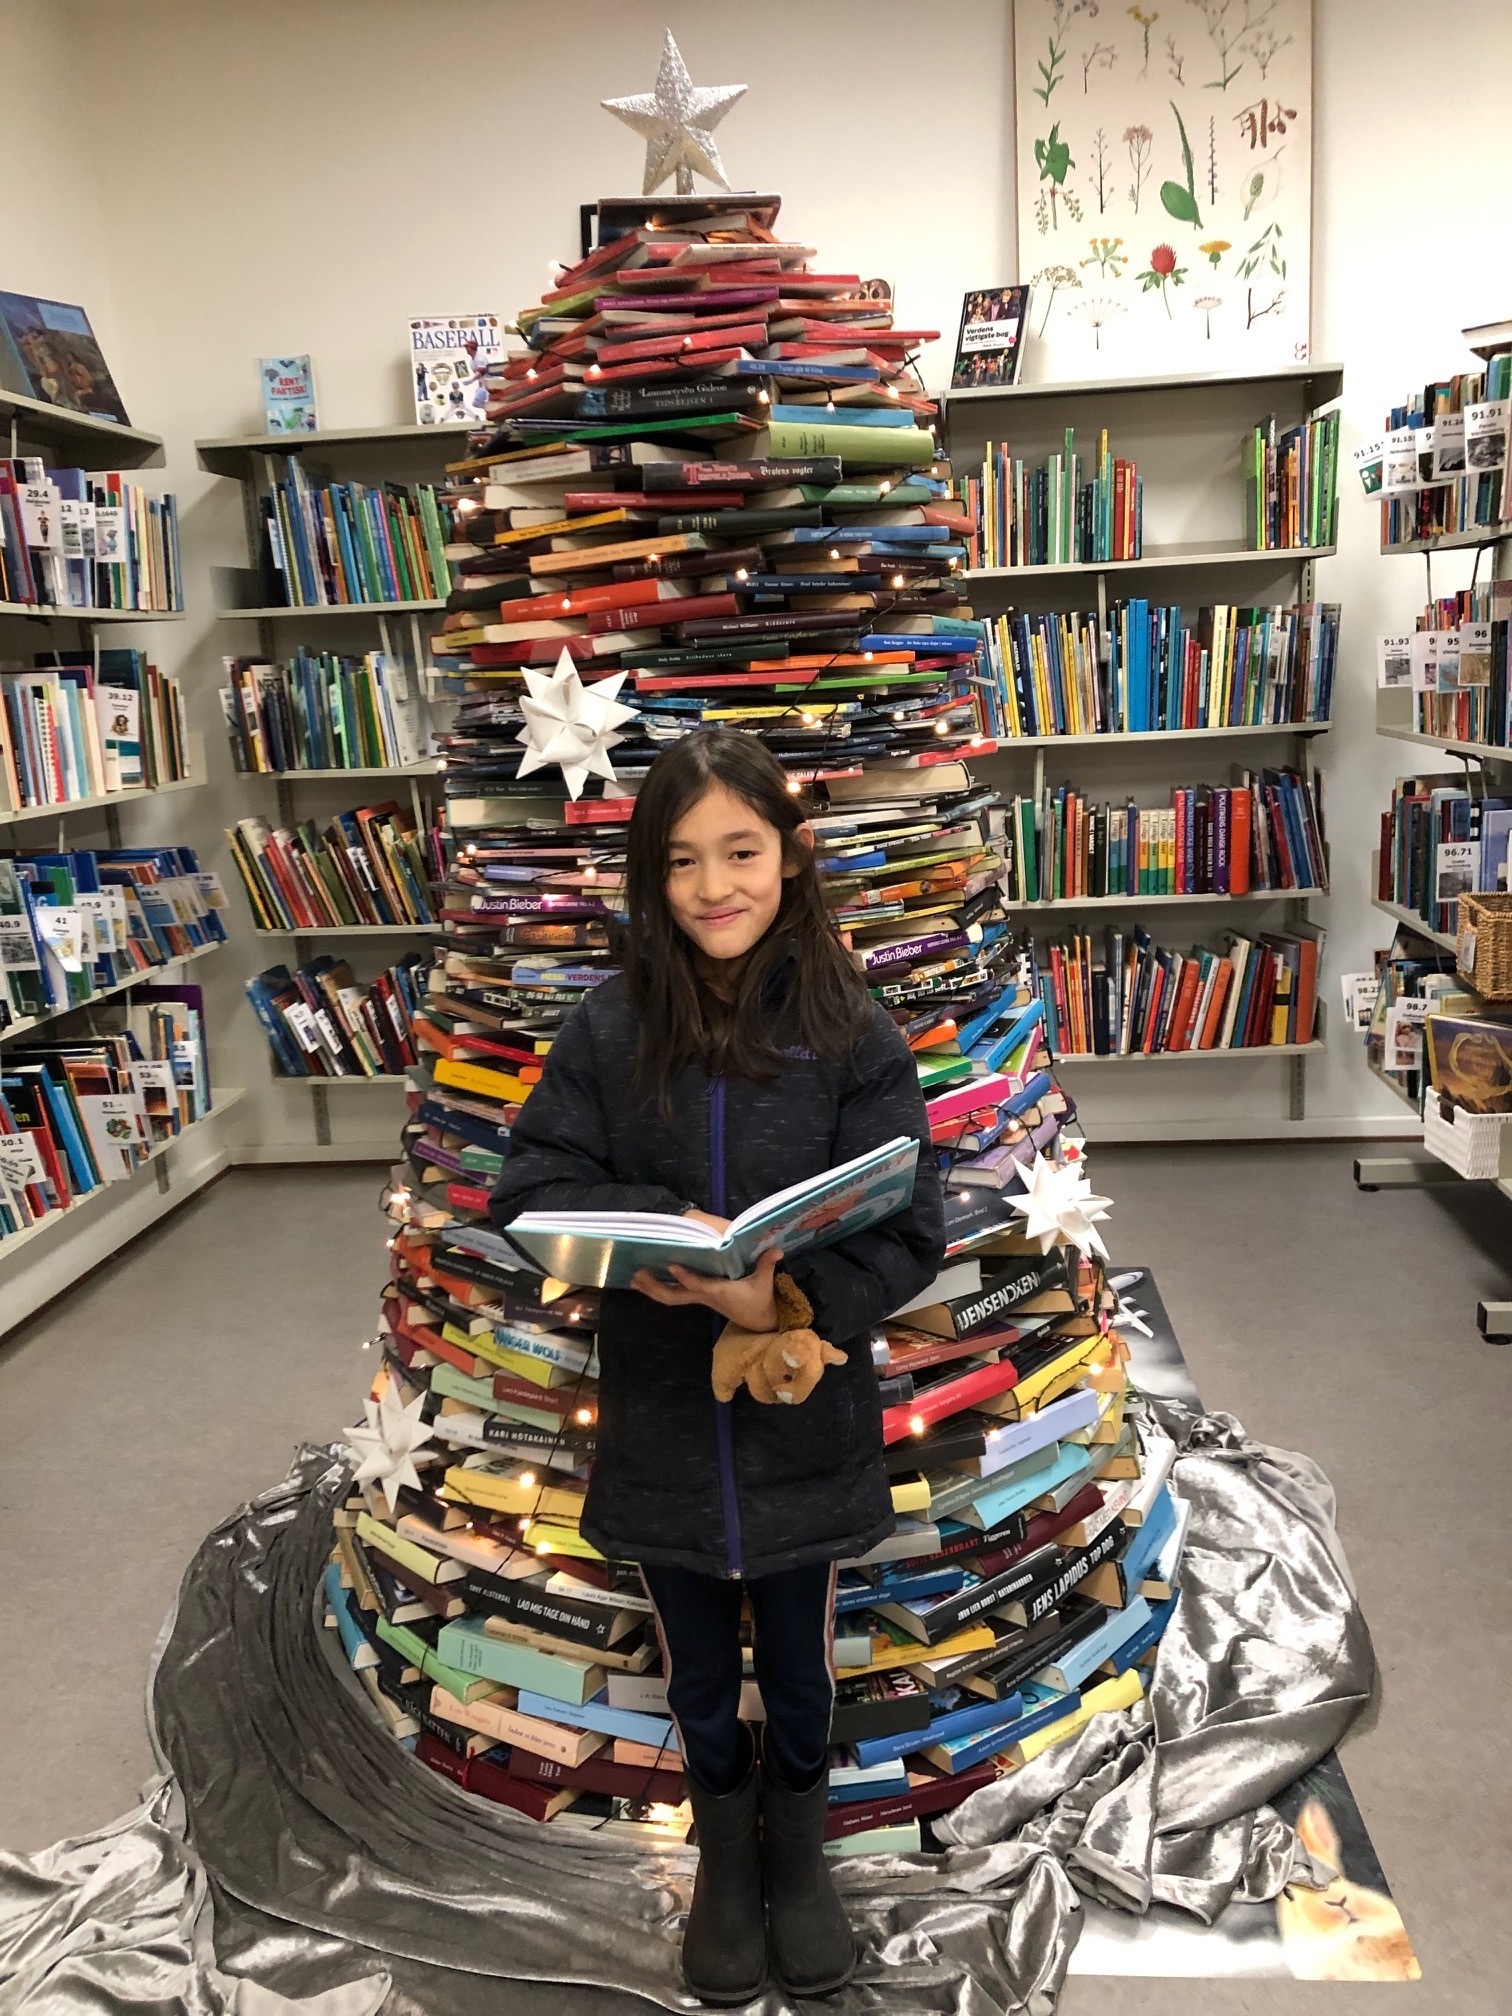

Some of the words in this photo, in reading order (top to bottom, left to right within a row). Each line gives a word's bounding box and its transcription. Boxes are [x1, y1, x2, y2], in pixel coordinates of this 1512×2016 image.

[966, 326, 994, 335] Verdens
[412, 329, 500, 349] BASEBALL
[965, 333, 995, 342] vigtigste
[697, 382, 727, 393] Gideon
[1472, 408, 1503, 420] 91.91
[27, 489, 48, 498] 29.4
[1475, 629, 1487, 638] 96
[1384, 637, 1410, 646] 91.93
[1447, 637, 1460, 645] 95
[108, 692, 133, 701] 39.12
[1219, 794, 1227, 827] POLITIKENS
[1219, 828, 1227, 849] DANSK
[1219, 849, 1227, 867] ROCK
[1444, 848, 1472, 857] 96.71
[481, 898, 509, 911] Justin
[509, 898, 543, 910] Bieber
[872, 950, 896, 966] Justin
[895, 943, 923, 960] Bieber
[567, 973, 605, 982] VERDENS
[1406, 1003, 1428, 1011] 98.7
[1, 1138, 24, 1147] 50.1
[489, 1428, 509, 1439] KARI
[905, 1554, 928, 1568] SOFIE
[928, 1537, 979, 1561] SARENBRANT
[983, 1528, 1011, 1544] Tiggeren
[1032, 1588, 1054, 1622] JENS
[1053, 1556, 1089, 1601] LAPIDUS
[1090, 1546, 1103, 1564] TOP
[1102, 1534, 1115, 1556] DOG
[469, 1584, 481, 1594] TOVE
[482, 1588, 511, 1603] ALSTERDAL
[878, 1591, 891, 1600] dage
[969, 1603, 981, 1615] LIER
[981, 1593, 996, 1609] HORST
[517, 1598, 529, 1610] LAD
[529, 1602, 543, 1615] MIG
[543, 1606, 559, 1620] TAGE
[559, 1611, 571, 1624] DIN
[570, 1614, 591, 1630] HÅND
[507, 1725, 523, 1737] Inden
[530, 1732, 542, 1744] blev
[892, 1742, 905, 1752] Sara
